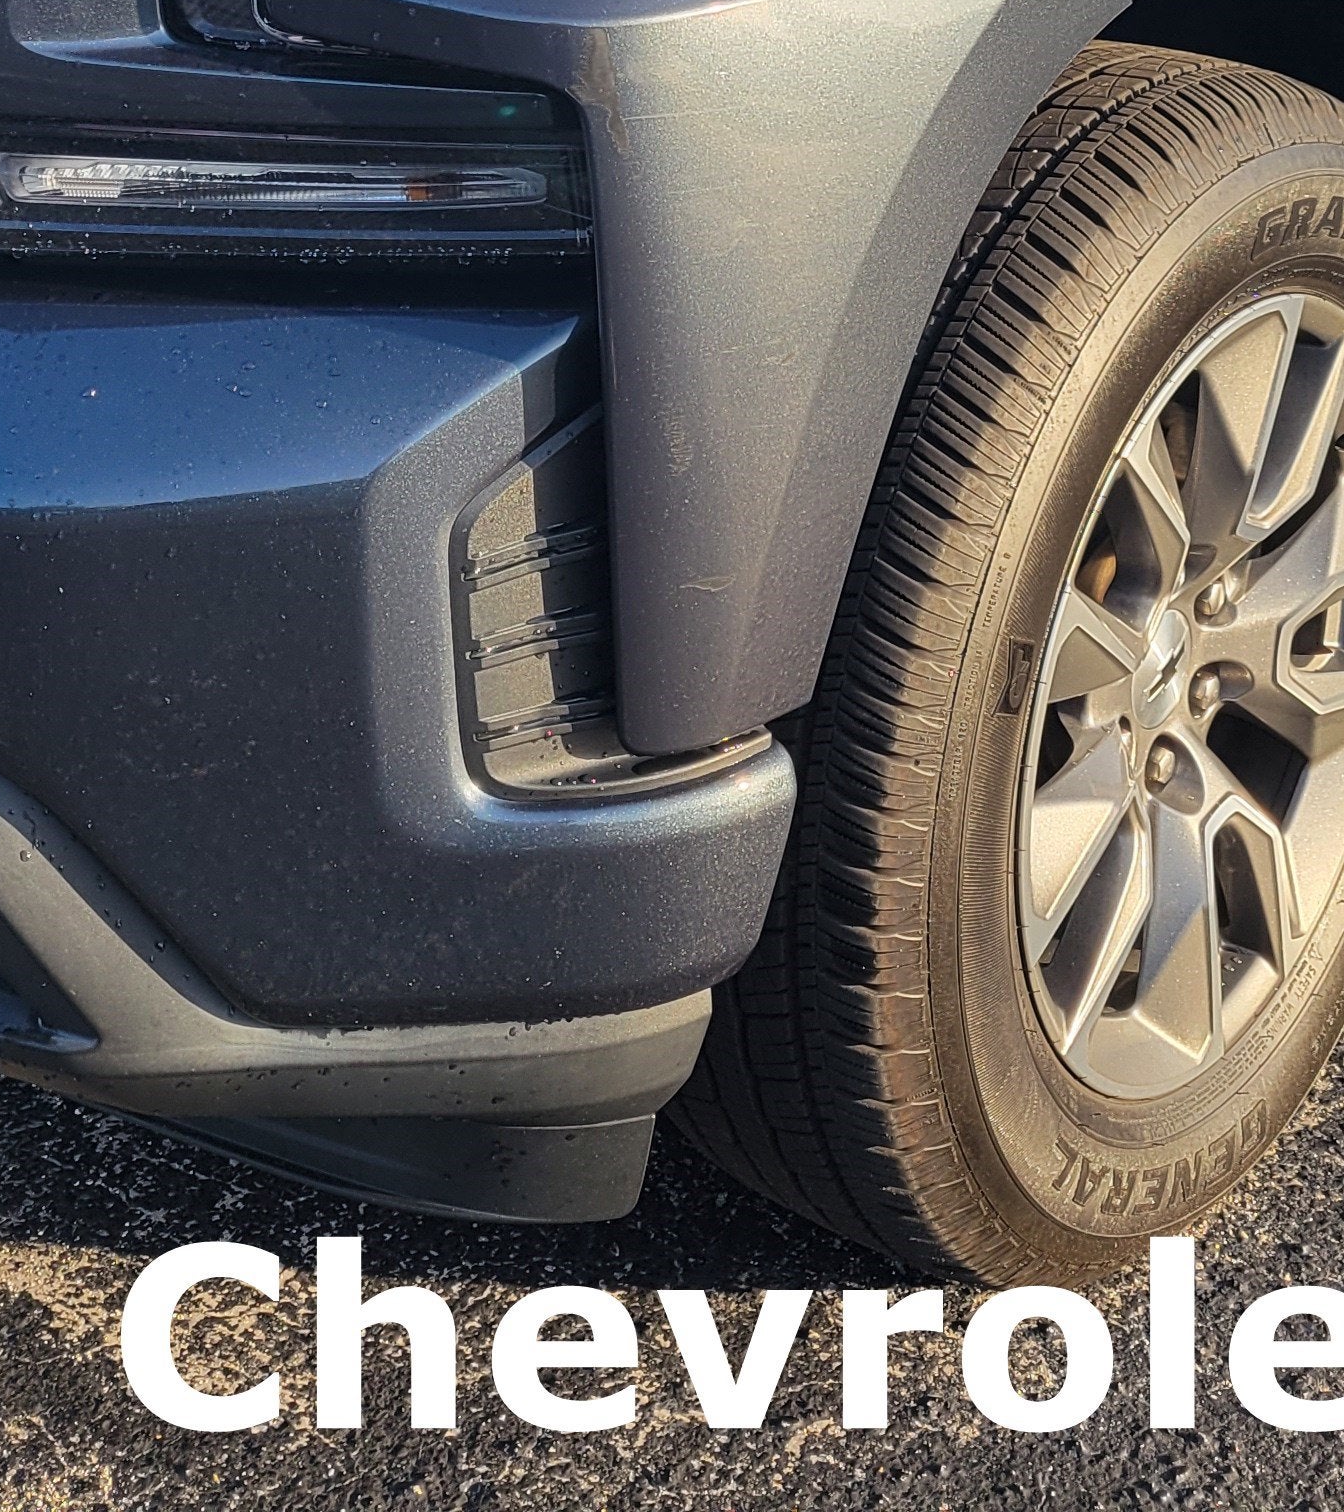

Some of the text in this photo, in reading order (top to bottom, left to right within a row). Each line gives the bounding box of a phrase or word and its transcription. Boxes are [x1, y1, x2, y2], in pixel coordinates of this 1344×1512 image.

[982, 565, 1008, 628] TEMPERATURE
[1295, 964, 1316, 1000] SAFETY
[1051, 1098, 1268, 1216] GENERAL
